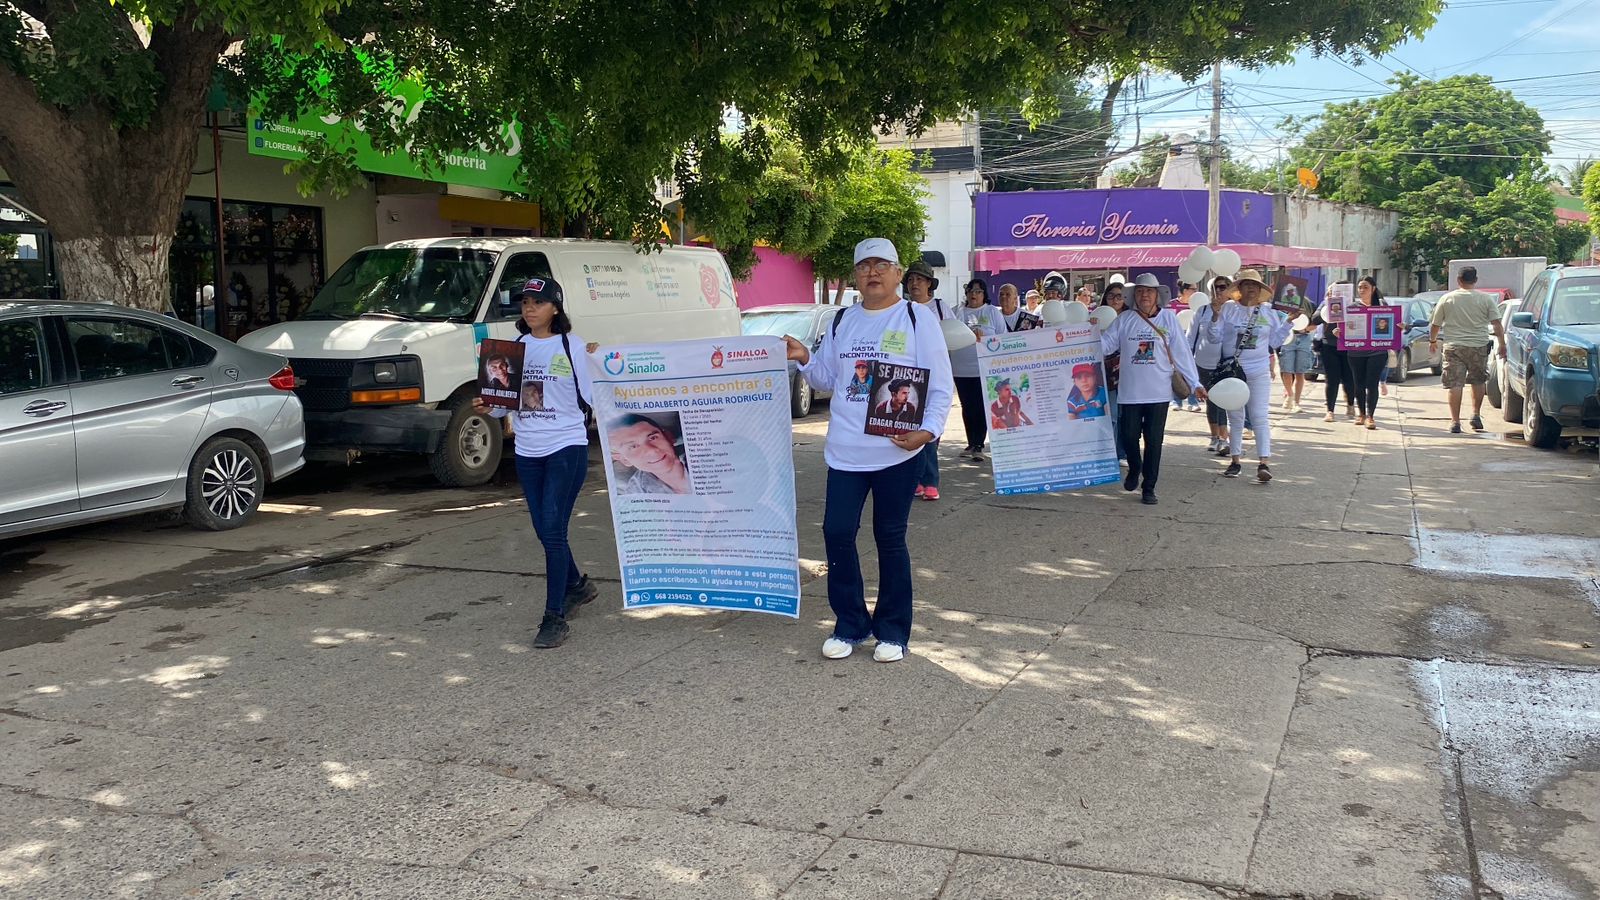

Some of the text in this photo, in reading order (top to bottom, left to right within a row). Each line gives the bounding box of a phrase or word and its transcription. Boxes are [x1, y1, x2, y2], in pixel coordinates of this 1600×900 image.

[264, 140, 296, 152] FLORERIA
[445, 153, 487, 170] oreria
[1010, 210, 1179, 242] Floreria Yazmin
[1002, 342, 1027, 350] Sinaloa
[727, 348, 768, 358] SINALOA
[628, 362, 665, 374] Sinaloa
[1012, 363, 1041, 372] OSVALDO
[1042, 359, 1070, 368] FELICIAN
[879, 364, 925, 384] SE BUSCA
[614, 385, 677, 400] Ayúdanos
[681, 386, 688, 394] a
[692, 380, 759, 393] encontrar
[644, 400, 689, 408] ADALBERTO
[692, 396, 723, 406] AGUIAR
[726, 393, 772, 404] RODRIGUEZ
[869, 417, 920, 431] EDAGAR OSVALDO
[710, 568, 742, 576] referente
[712, 578, 733, 586] ayuda
